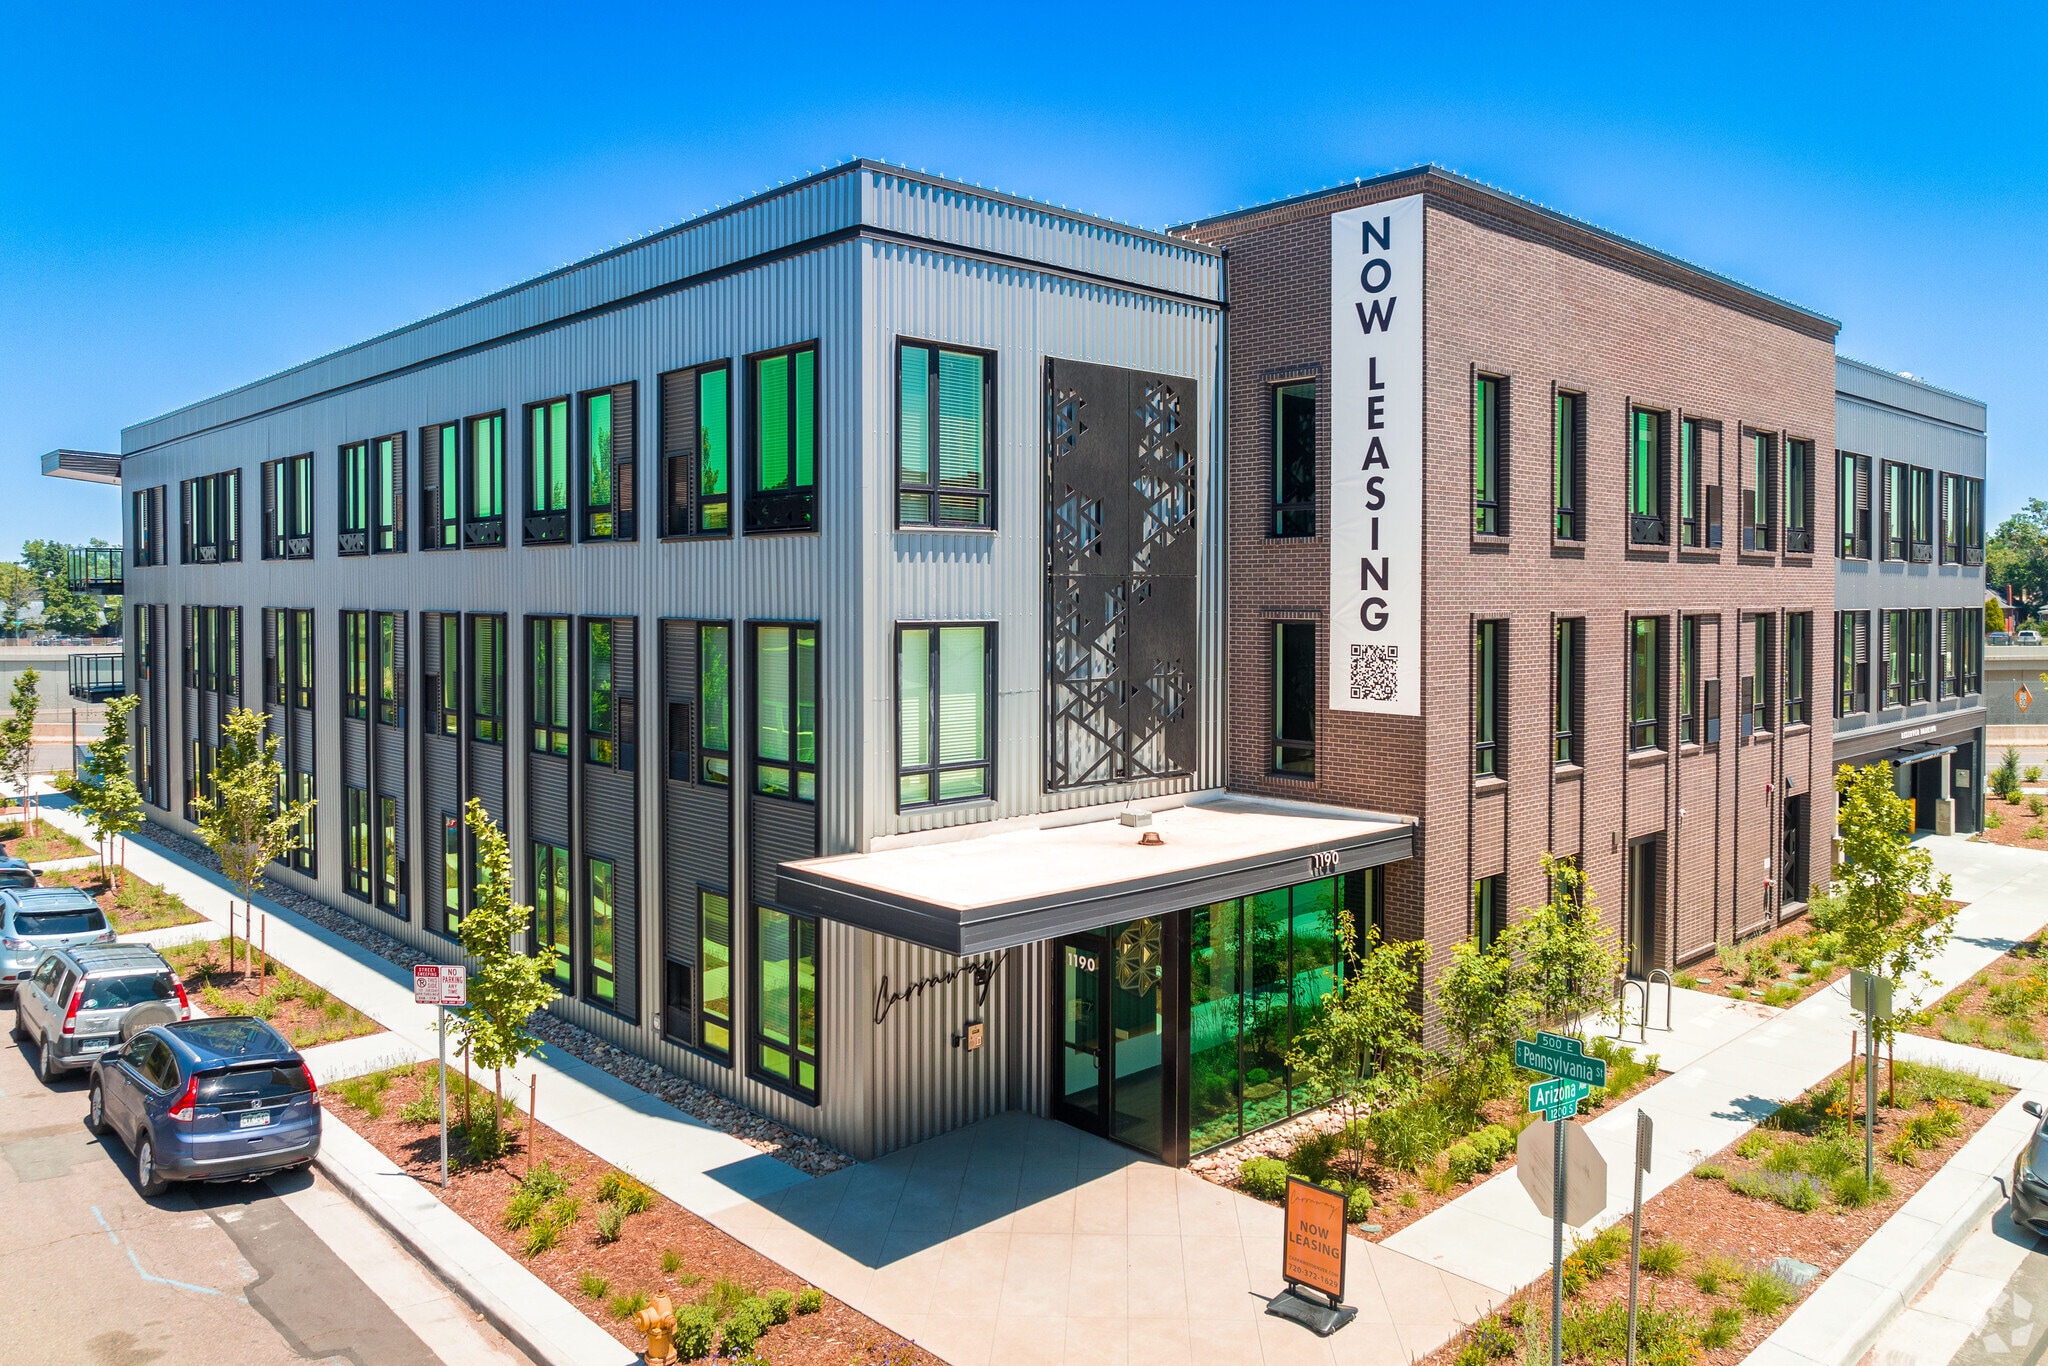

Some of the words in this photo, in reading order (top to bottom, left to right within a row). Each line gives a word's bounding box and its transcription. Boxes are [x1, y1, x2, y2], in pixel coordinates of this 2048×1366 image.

[1355, 216, 1397, 335] NOW
[1360, 357, 1390, 632] LEASING
[1315, 852, 1339, 868] 1190
[1067, 953, 1095, 972] 1190
[1542, 1036, 1562, 1050] 500
[1567, 1042, 1573, 1052] E
[1518, 1048, 1522, 1057] S
[1523, 1046, 1593, 1082] Pennsylvania
[1596, 1068, 1604, 1078] St
[1536, 1082, 1576, 1107] Arizona
[1550, 1107, 1566, 1120] 1200
[1568, 1104, 1573, 1114] S
[1300, 1220, 1329, 1240] NOW
[1289, 1232, 1340, 1259] LEASING
[1288, 1263, 1338, 1288] 720-372-1629
